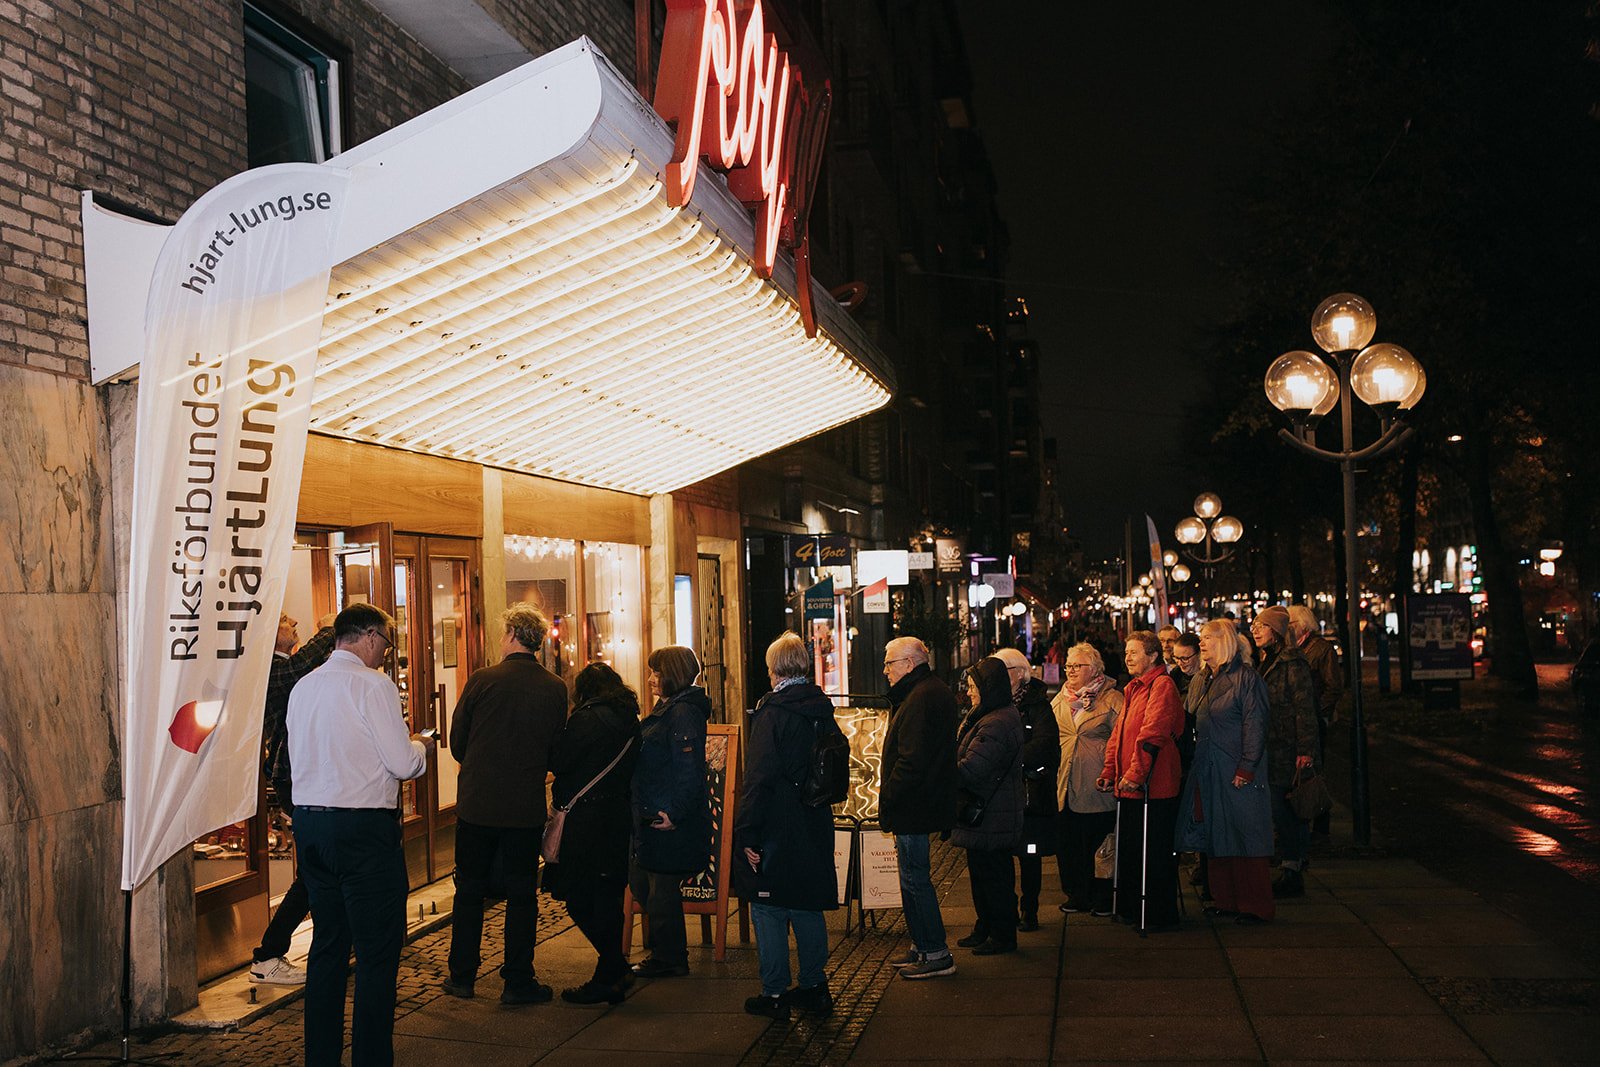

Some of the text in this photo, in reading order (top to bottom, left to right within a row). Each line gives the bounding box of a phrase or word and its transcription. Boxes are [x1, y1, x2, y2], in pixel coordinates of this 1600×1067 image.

[181, 191, 331, 295] hjart-lung.se
[169, 352, 223, 661] Riksförbundet
[216, 357, 297, 661] HjärtLung
